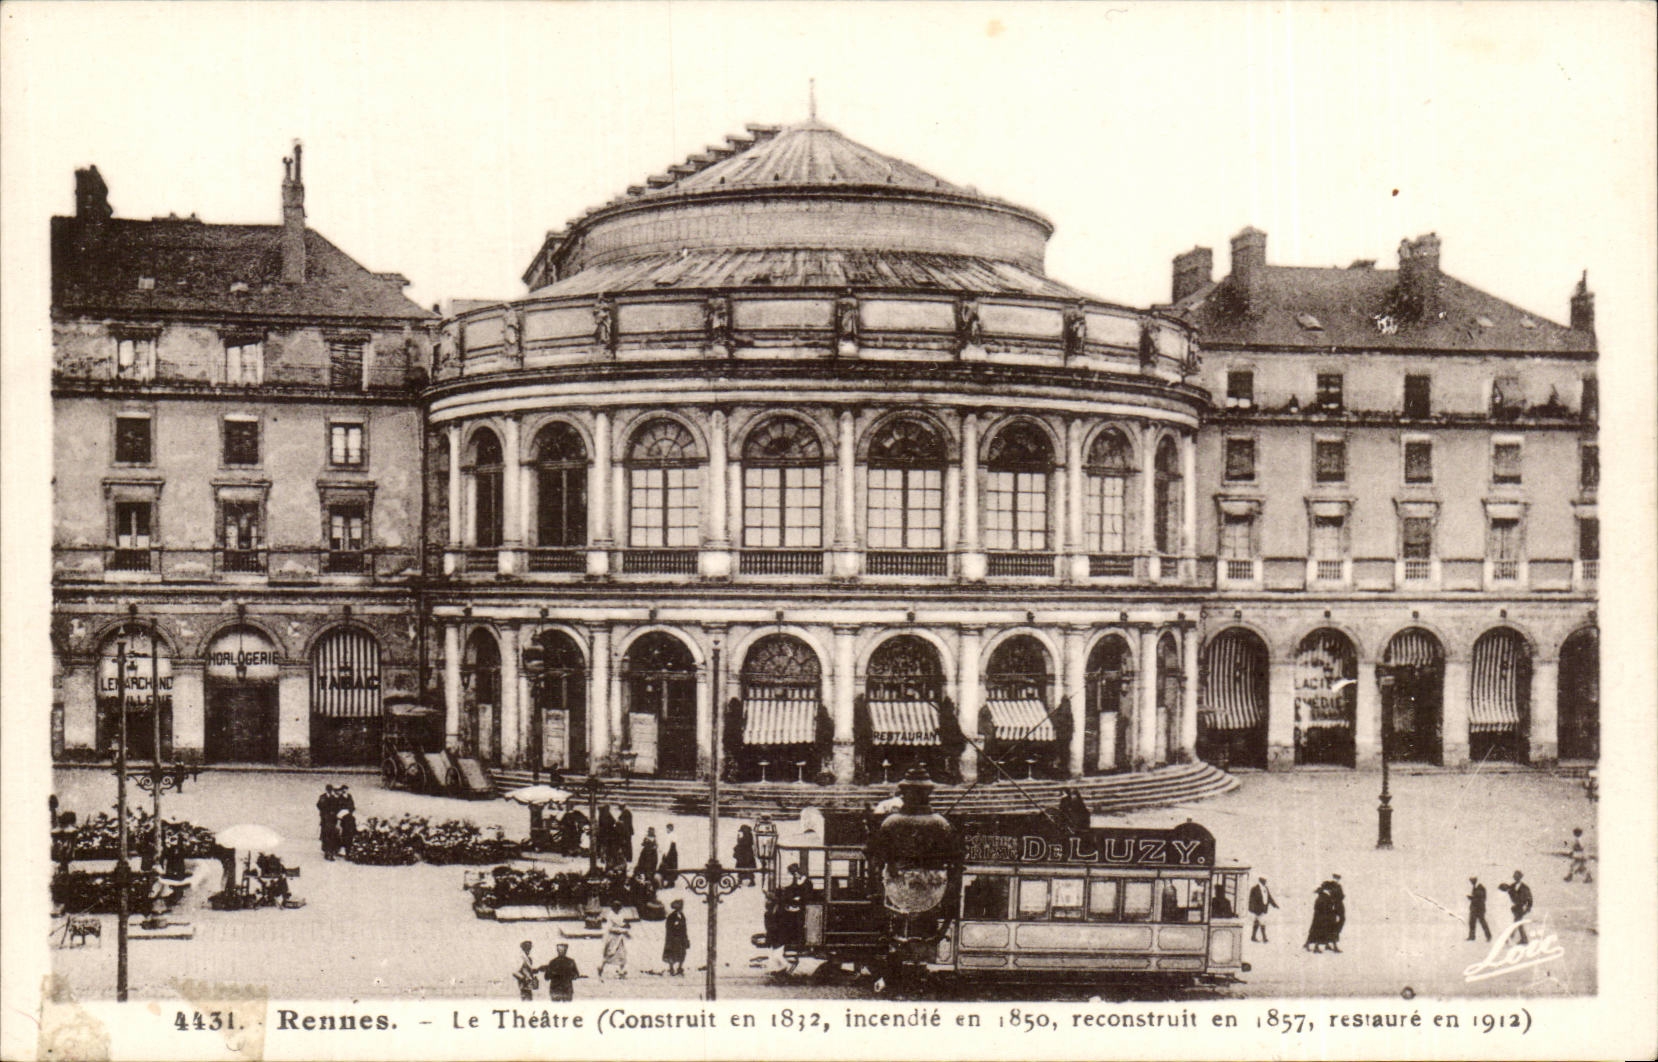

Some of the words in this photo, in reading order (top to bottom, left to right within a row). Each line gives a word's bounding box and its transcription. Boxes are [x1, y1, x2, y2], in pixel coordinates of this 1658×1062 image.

[207, 651, 280, 666] HORLOGERIE
[100, 677, 174, 691] LEARCHND
[318, 675, 381, 690] TABAC
[873, 730, 942, 742] RESTAURAN
[1067, 837, 1206, 864] LUZY.
